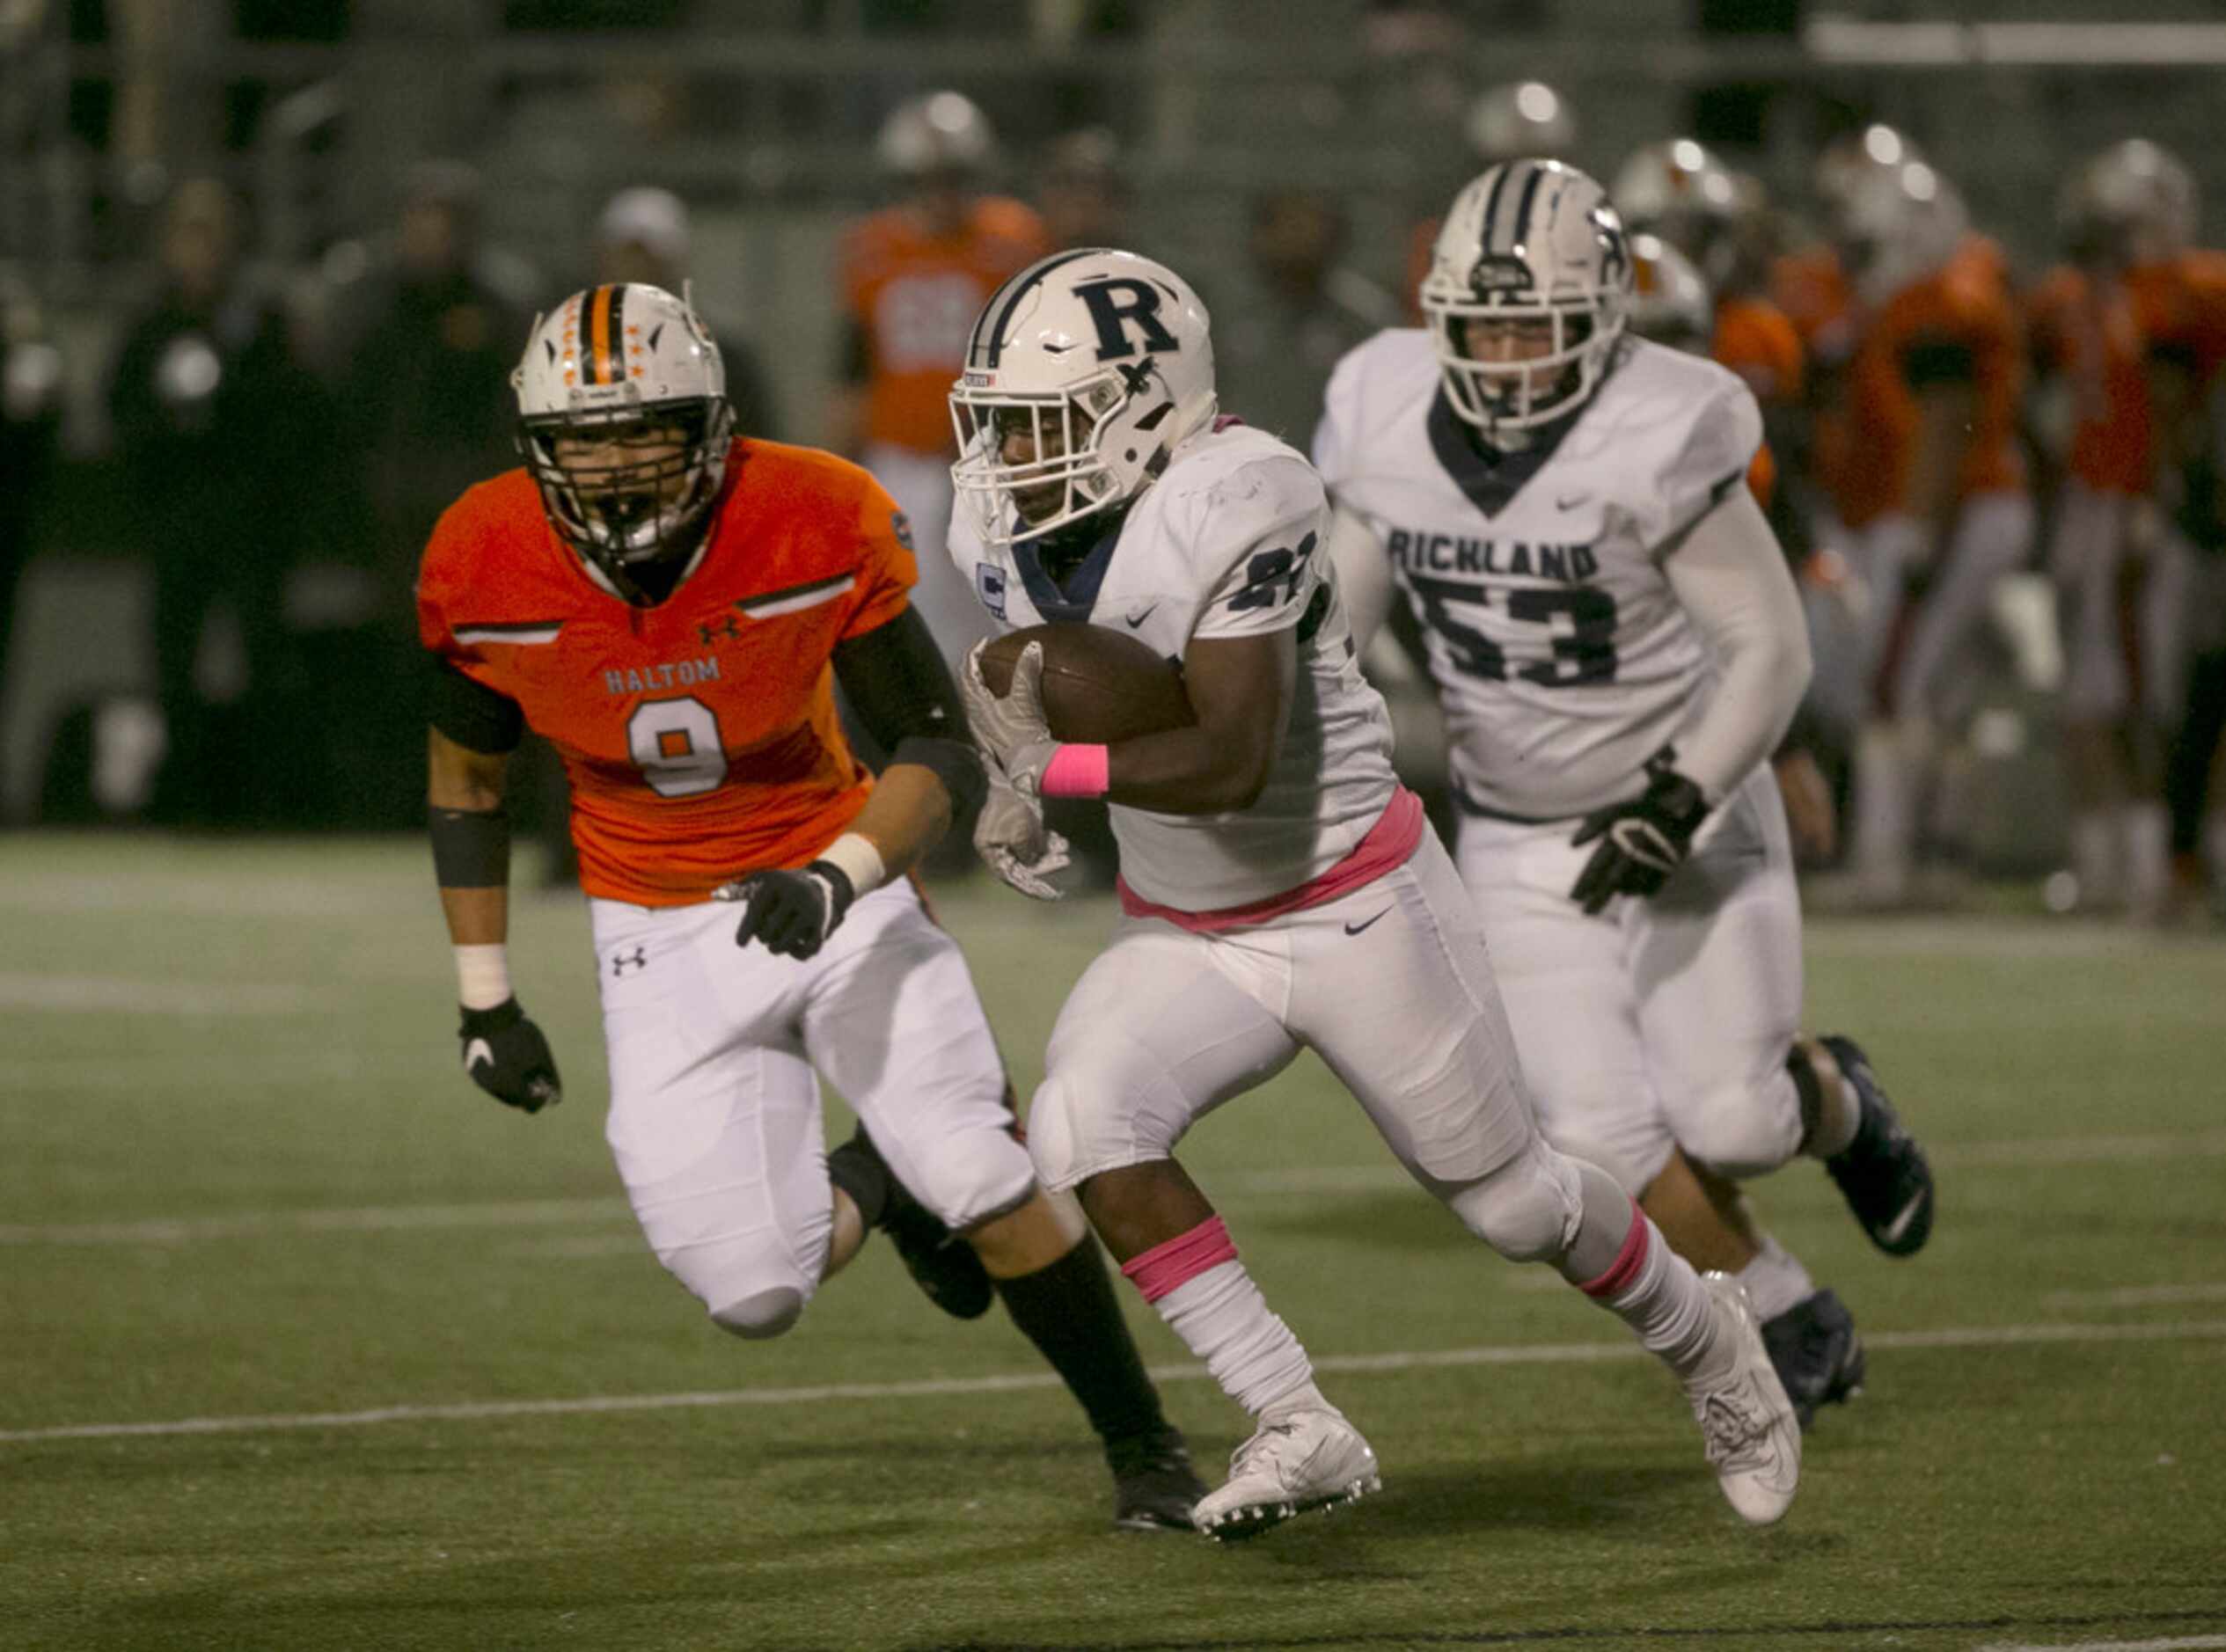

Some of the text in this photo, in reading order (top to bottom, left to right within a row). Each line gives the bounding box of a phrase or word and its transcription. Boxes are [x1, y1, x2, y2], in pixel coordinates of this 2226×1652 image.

[1072, 278, 1179, 362] R
[1388, 528, 1599, 582] RICHLAND
[1408, 574, 1617, 687] 53
[604, 655, 721, 694] HALTOM
[626, 693, 729, 799] 9
